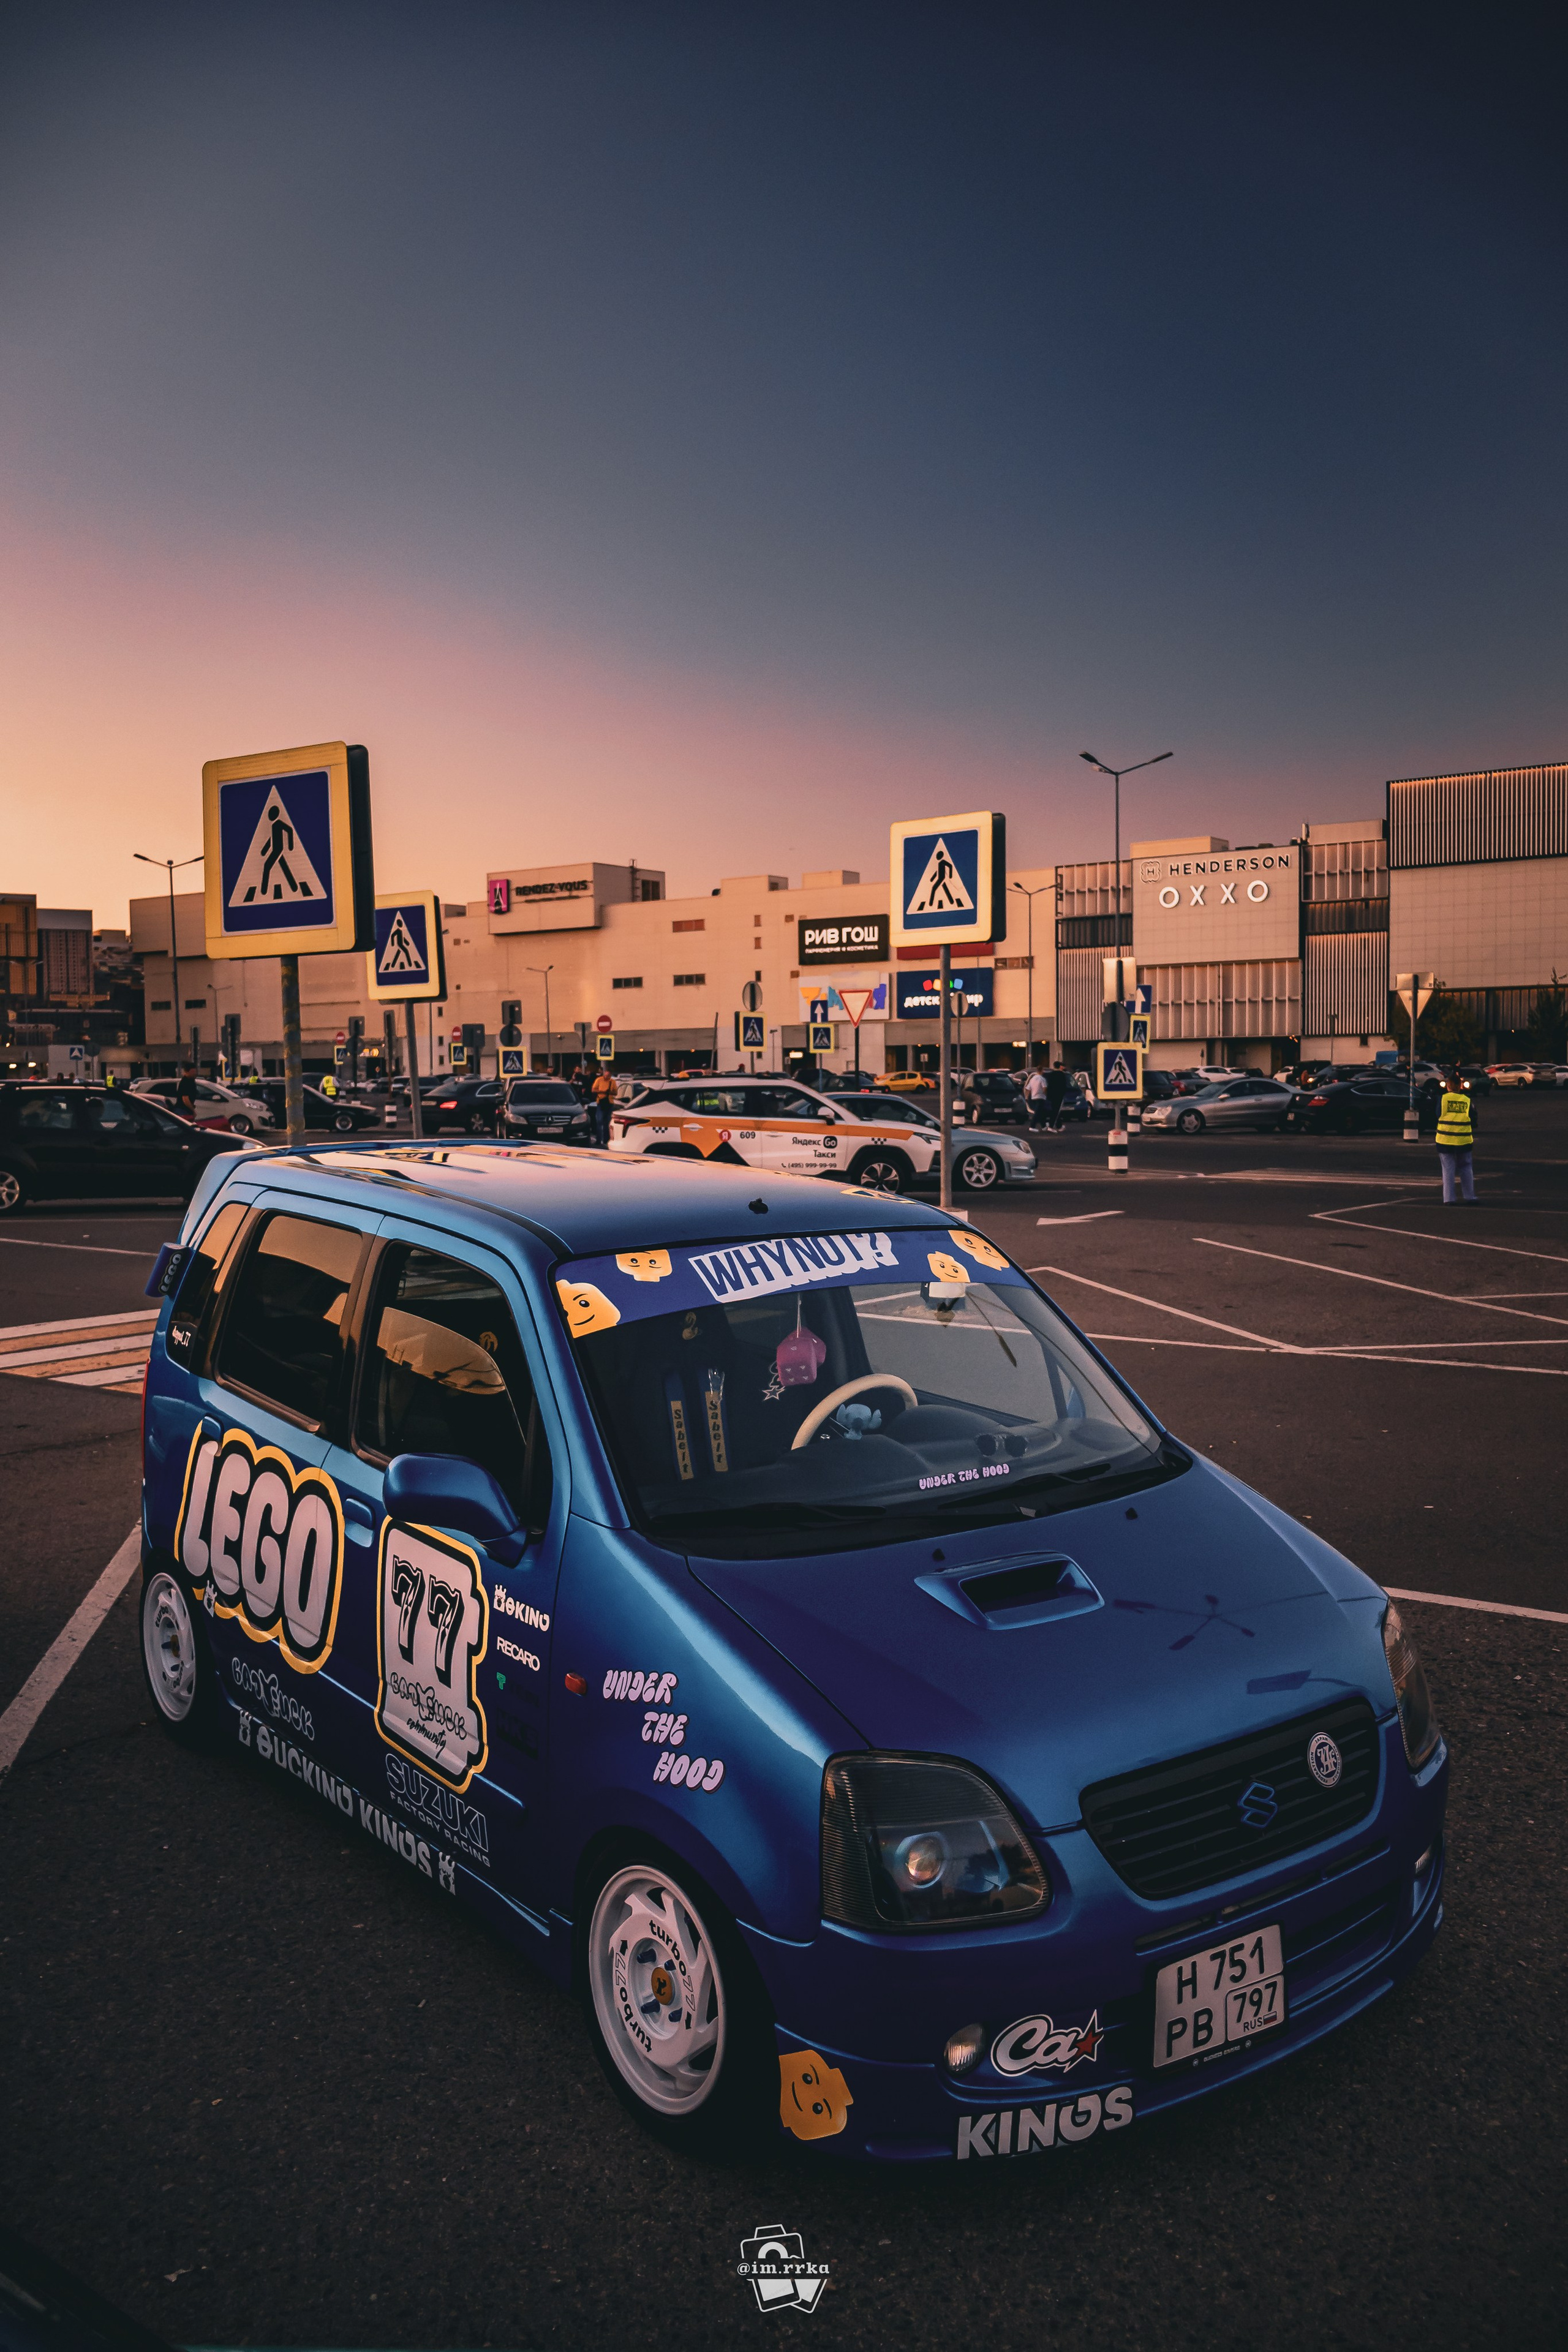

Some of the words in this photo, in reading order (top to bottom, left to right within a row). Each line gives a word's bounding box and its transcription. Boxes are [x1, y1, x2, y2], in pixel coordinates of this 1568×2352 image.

[1169, 855, 1289, 876] HENDERSON
[515, 880, 589, 896] RENDEZ-VOUS
[1159, 880, 1269, 909] OXXO
[805, 928, 839, 945] РИВ
[842, 926, 879, 943] ГОШ
[904, 995, 944, 1008] детск
[966, 994, 983, 1007] ир
[792, 1137, 821, 1146] Яндекс
[824, 1137, 837, 1147] Go
[813, 1149, 836, 1158] Такси
[674, 1409, 688, 1473] Sabelt
[709, 1400, 723, 1463] Sabelt
[919, 1473, 957, 1490] UNDER
[957, 1468, 980, 1482] THE
[982, 1463, 1009, 1477] HOOD
[183, 1440, 333, 1648] LEGO
[391, 1554, 466, 1689] 77
[497, 1636, 540, 1672] RECARO
[603, 1670, 677, 1705] UNDER
[641, 1711, 688, 1746] THE
[653, 1751, 724, 1792] HOOD
[385, 1753, 489, 1853] SUZUKI
[390, 1790, 440, 1833] FACTORY
[443, 1828, 491, 1868] RACING
[1209, 1936, 1265, 1991] 751
[1233, 1980, 1278, 2023] 797
[1243, 2017, 1263, 2032] RUS
[957, 2086, 1133, 2160] KINGS
